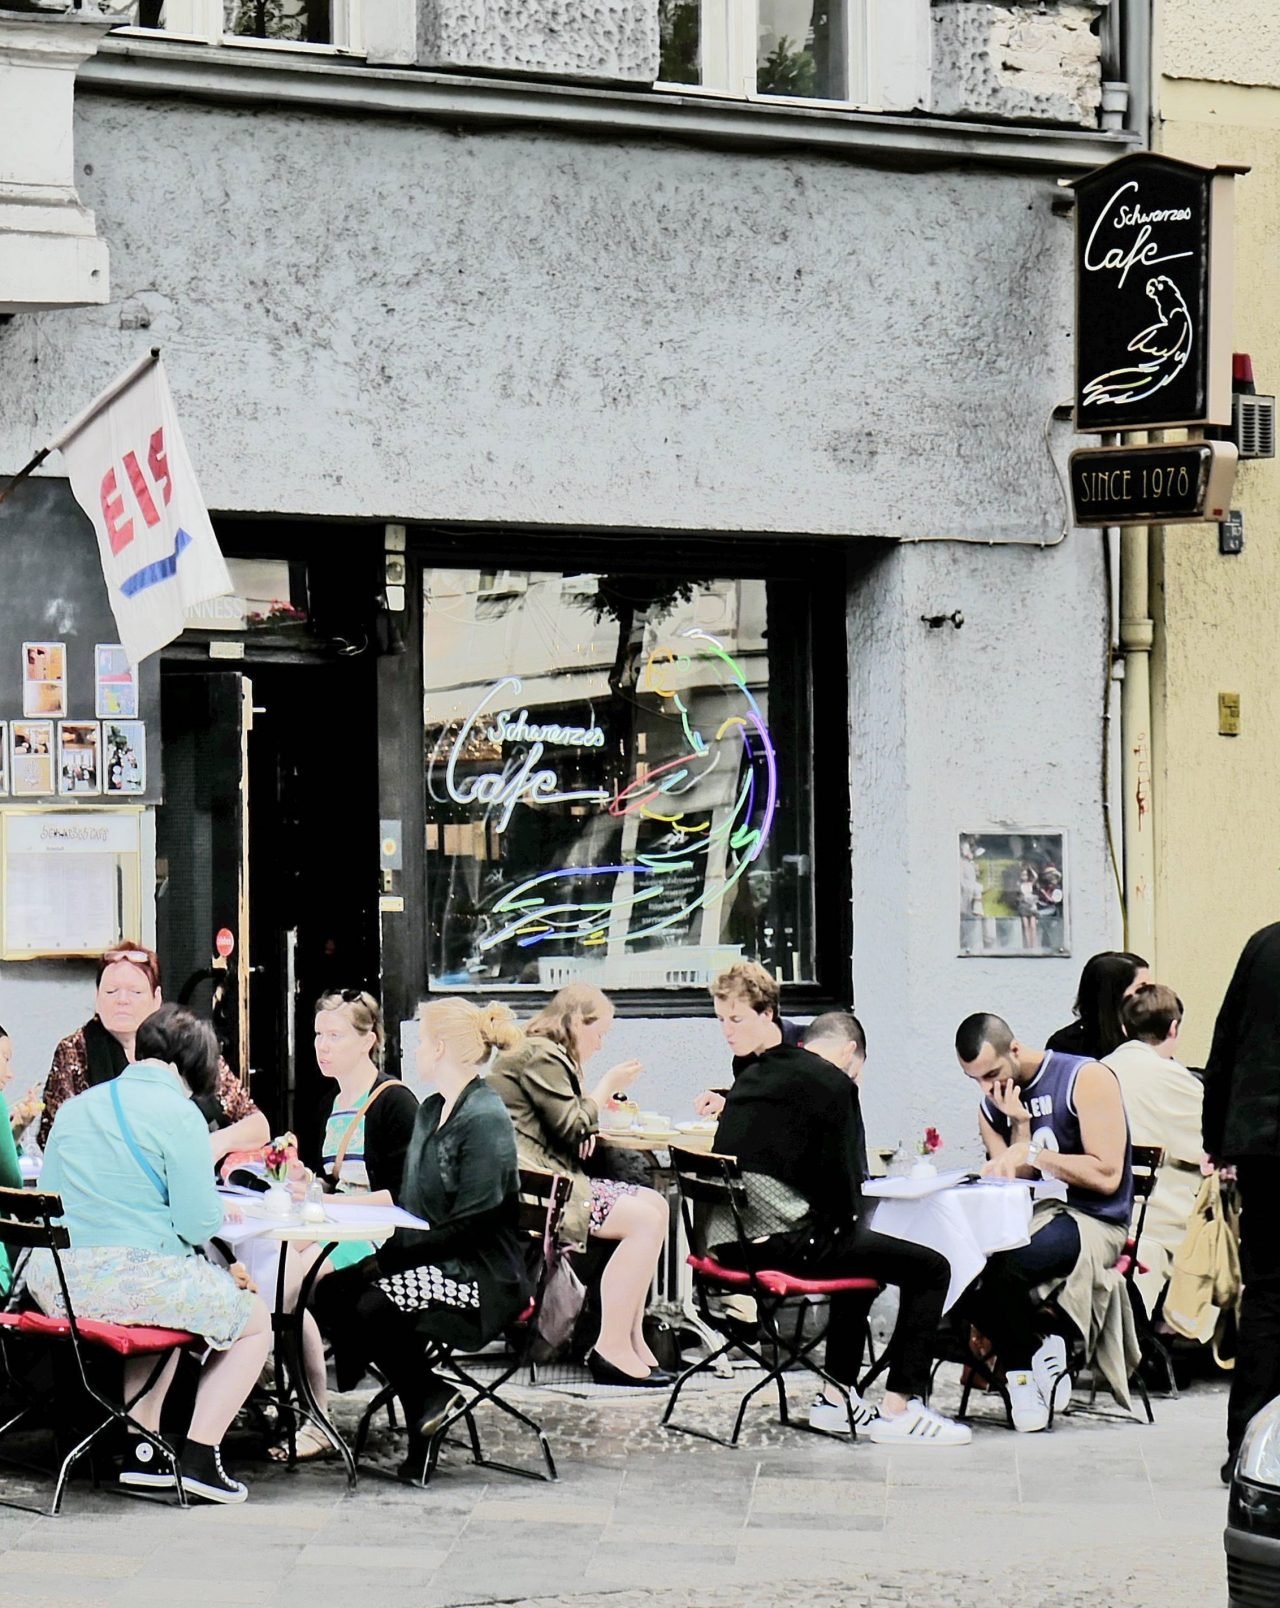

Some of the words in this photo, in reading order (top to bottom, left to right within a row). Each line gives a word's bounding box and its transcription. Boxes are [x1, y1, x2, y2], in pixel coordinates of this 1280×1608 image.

[1084, 181, 1194, 289] Cafe
[1113, 204, 1192, 229] Schwarzes
[99, 426, 173, 558] EIS
[1081, 470, 1132, 502] SINCE
[1142, 466, 1189, 499] 1978
[488, 709, 605, 747] Schwarzes
